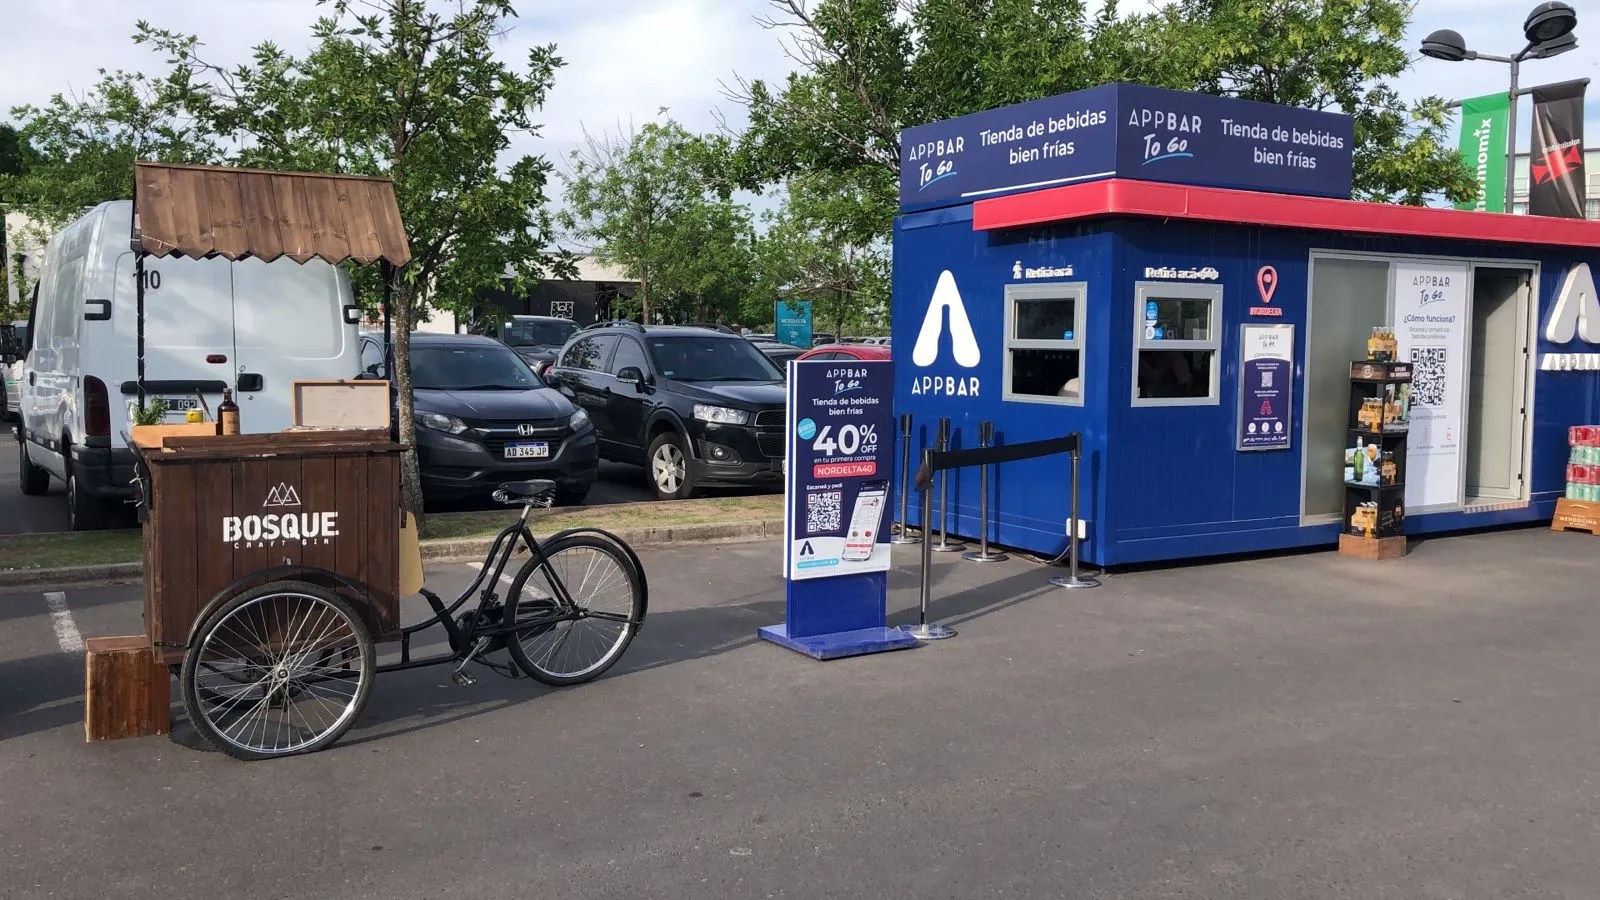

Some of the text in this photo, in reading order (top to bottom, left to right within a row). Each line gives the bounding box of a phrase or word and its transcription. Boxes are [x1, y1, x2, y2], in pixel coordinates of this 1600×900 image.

[980, 109, 1107, 147] Tienda de bebidas
[1128, 108, 1202, 134] APPBAR
[1221, 119, 1344, 149] Tienda de bebidas
[909, 136, 964, 162] APPBAR
[1009, 140, 1075, 165] bien frías
[1144, 133, 1161, 160] To
[1254, 146, 1317, 169] bien frías
[920, 162, 933, 187] To
[1413, 276, 1450, 287] APPBAR
[1426, 314, 1456, 323] funciona?
[1541, 353, 1600, 371] APPBA
[826, 369, 868, 378] APPBAR
[911, 376, 980, 397] APPBAR
[812, 398, 838, 406] Tienda
[850, 396, 880, 405] bebidas
[829, 407, 845, 416] bien
[520, 447, 535, 456] 345
[861, 445, 878, 454] OFF
[817, 465, 873, 475] NORDELTA40
[223, 512, 339, 542] BOSQUE
[234, 538, 330, 549] CRAFT GIN
